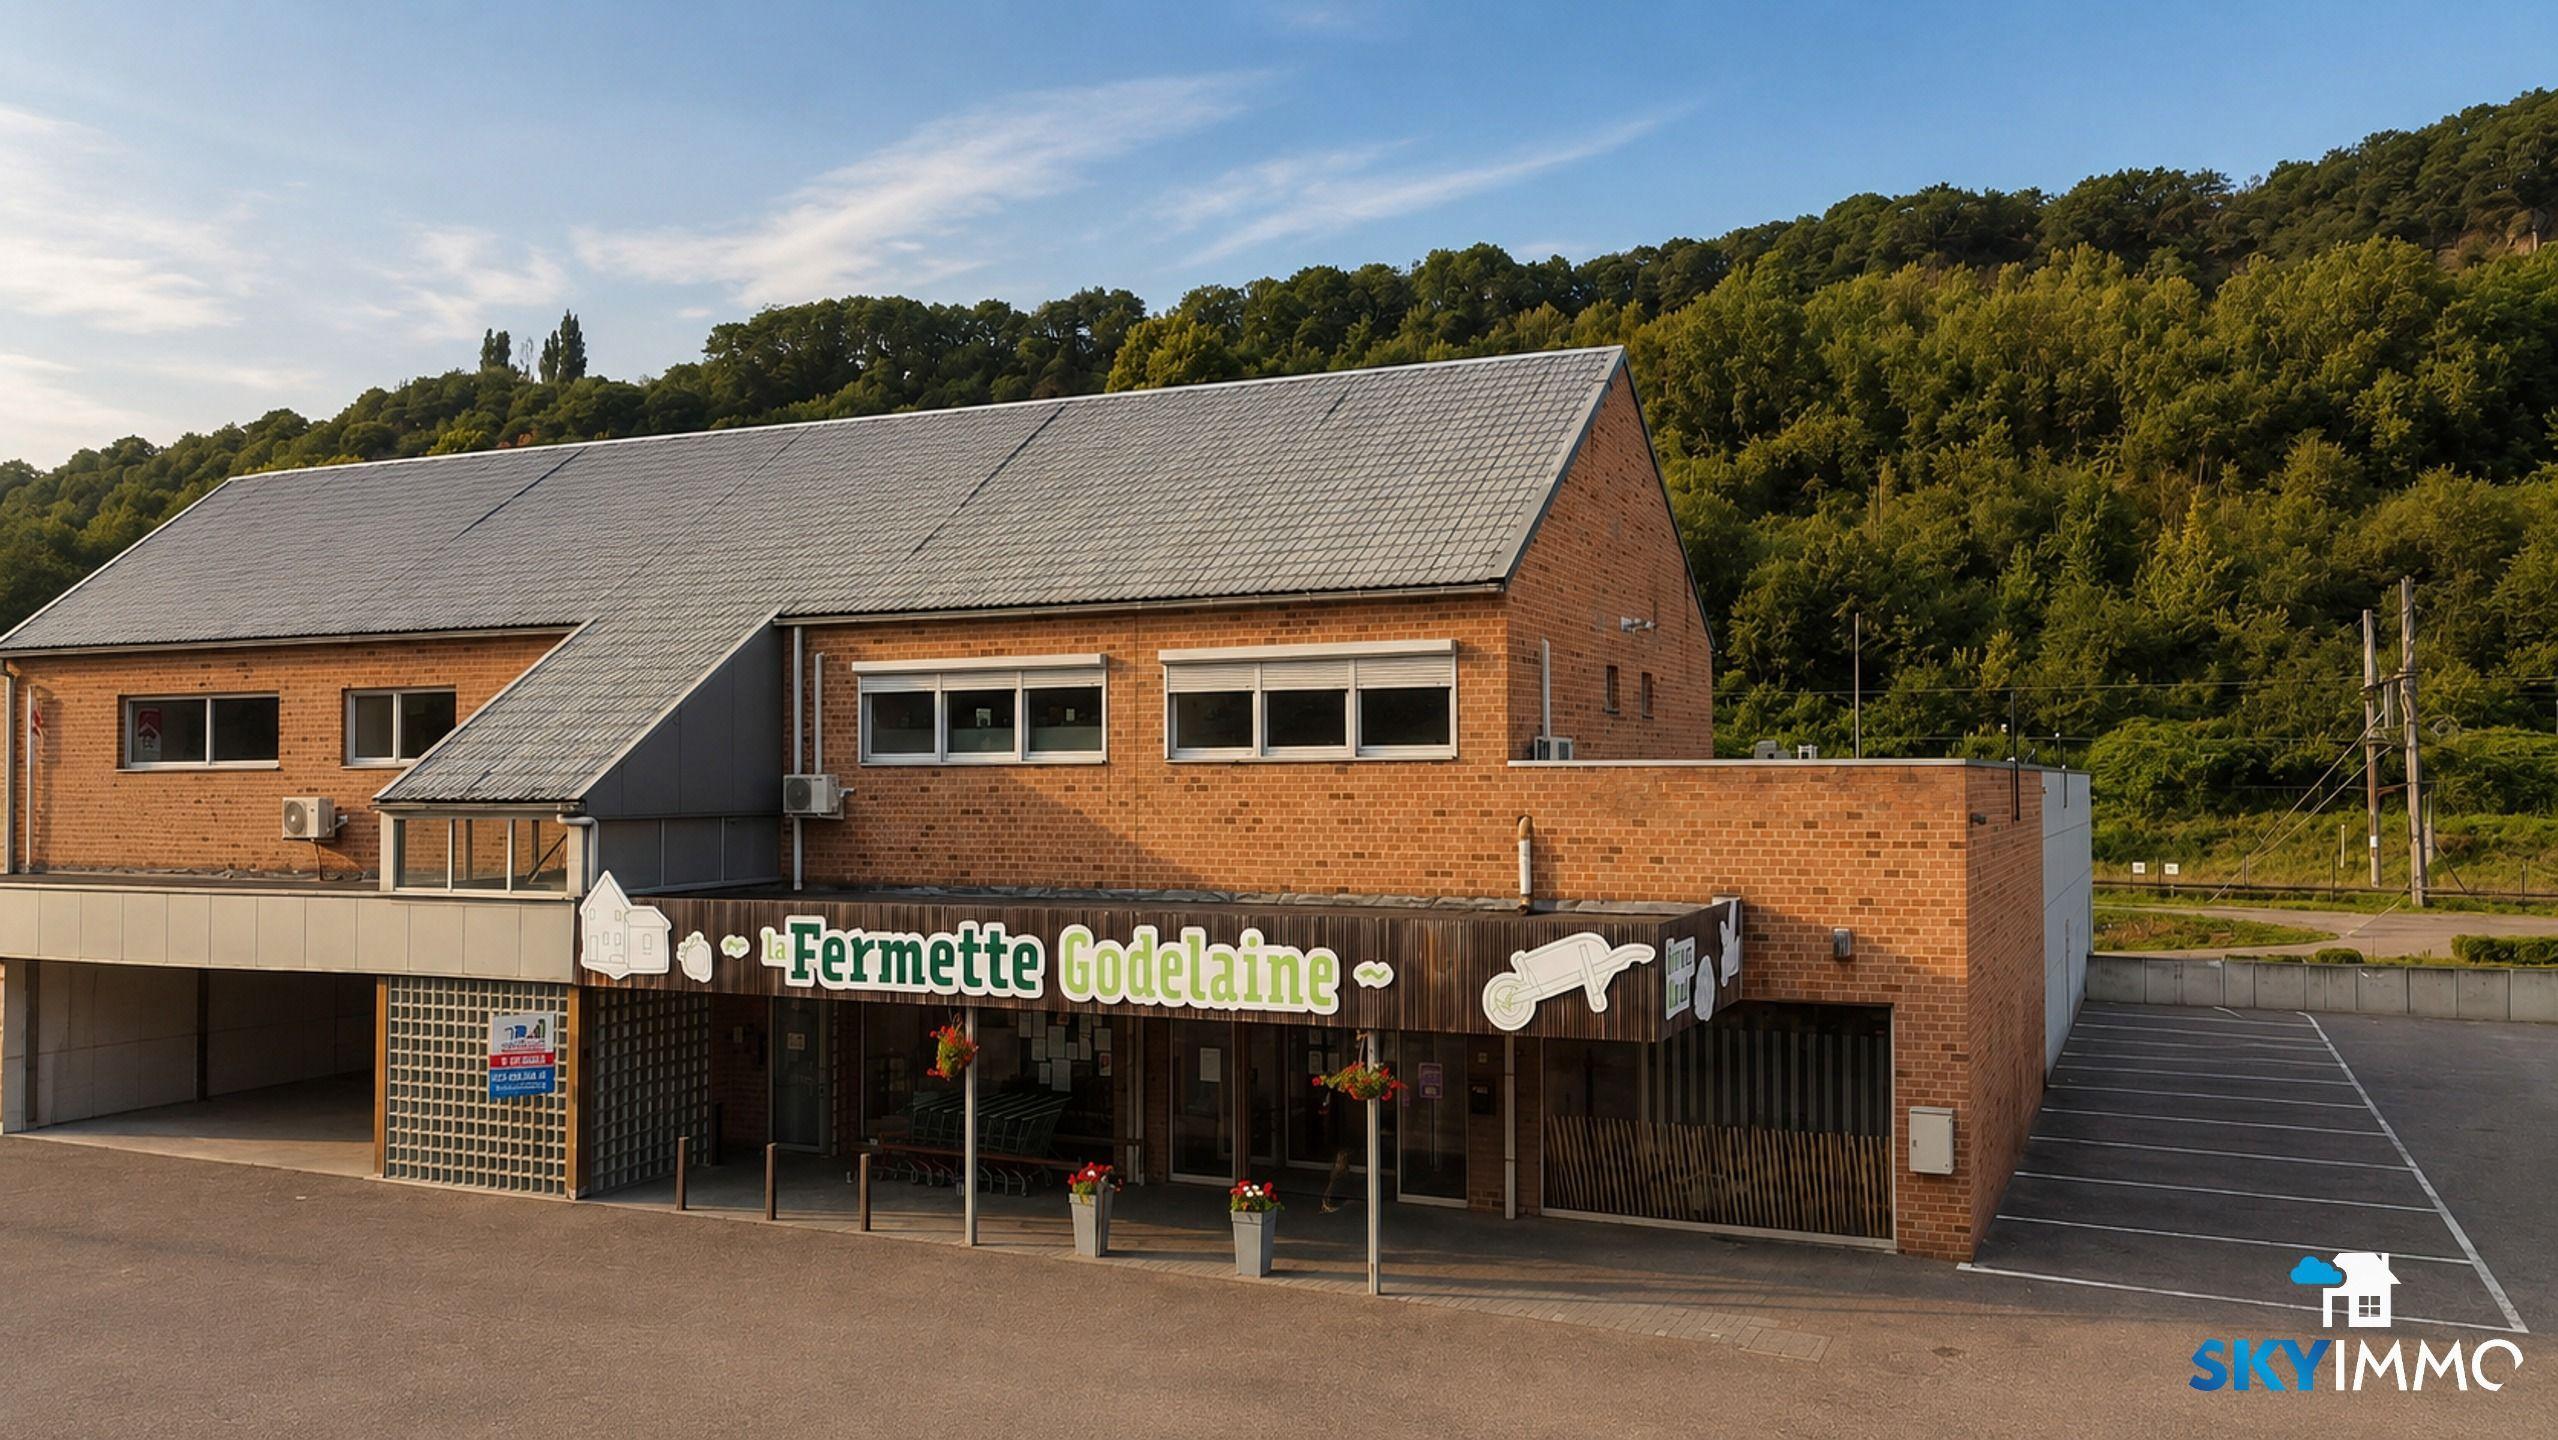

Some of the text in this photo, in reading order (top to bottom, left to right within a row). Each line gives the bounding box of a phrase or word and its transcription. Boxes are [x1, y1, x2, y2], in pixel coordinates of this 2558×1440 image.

[767, 922, 1334, 1007] la Fermette Godelaine
